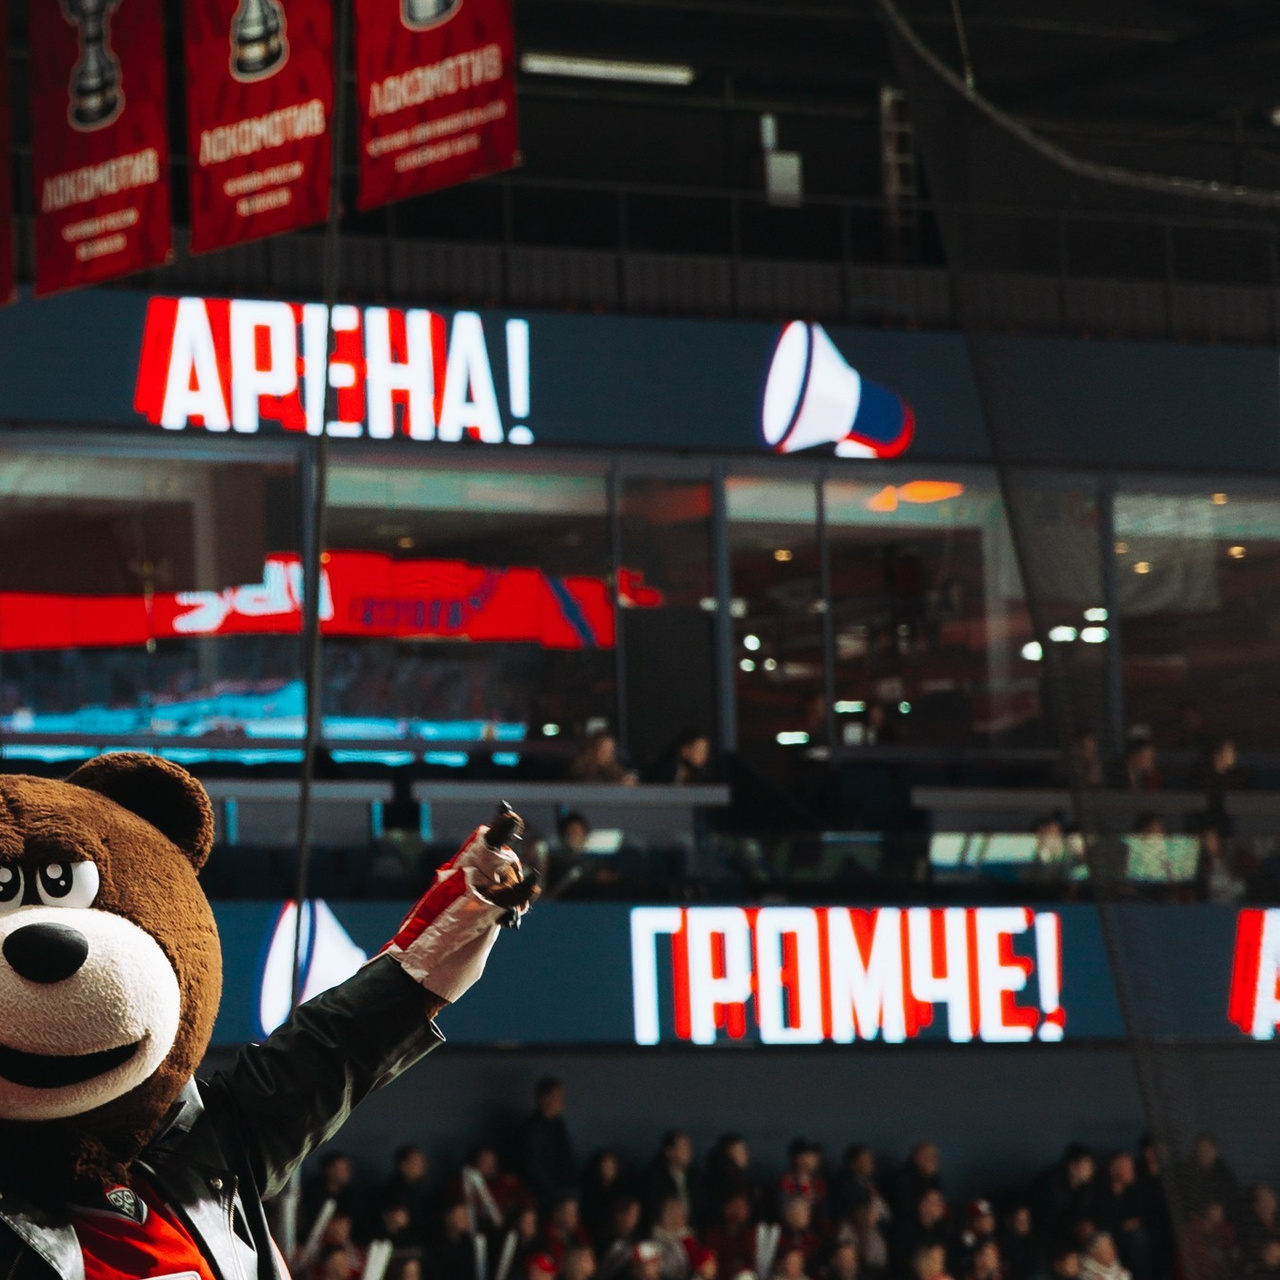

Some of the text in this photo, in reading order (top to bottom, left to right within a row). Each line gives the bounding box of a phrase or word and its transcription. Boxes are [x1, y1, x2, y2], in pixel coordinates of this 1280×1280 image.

[368, 42, 503, 119] ЛОКОМОТИВ
[199, 98, 326, 167] ЛОКОМОТИВ
[42, 147, 159, 213] ЛОКОМОТИВ
[140, 296, 534, 444] АРЕНА!
[630, 906, 1065, 1045] ГРОМЧЕ!
